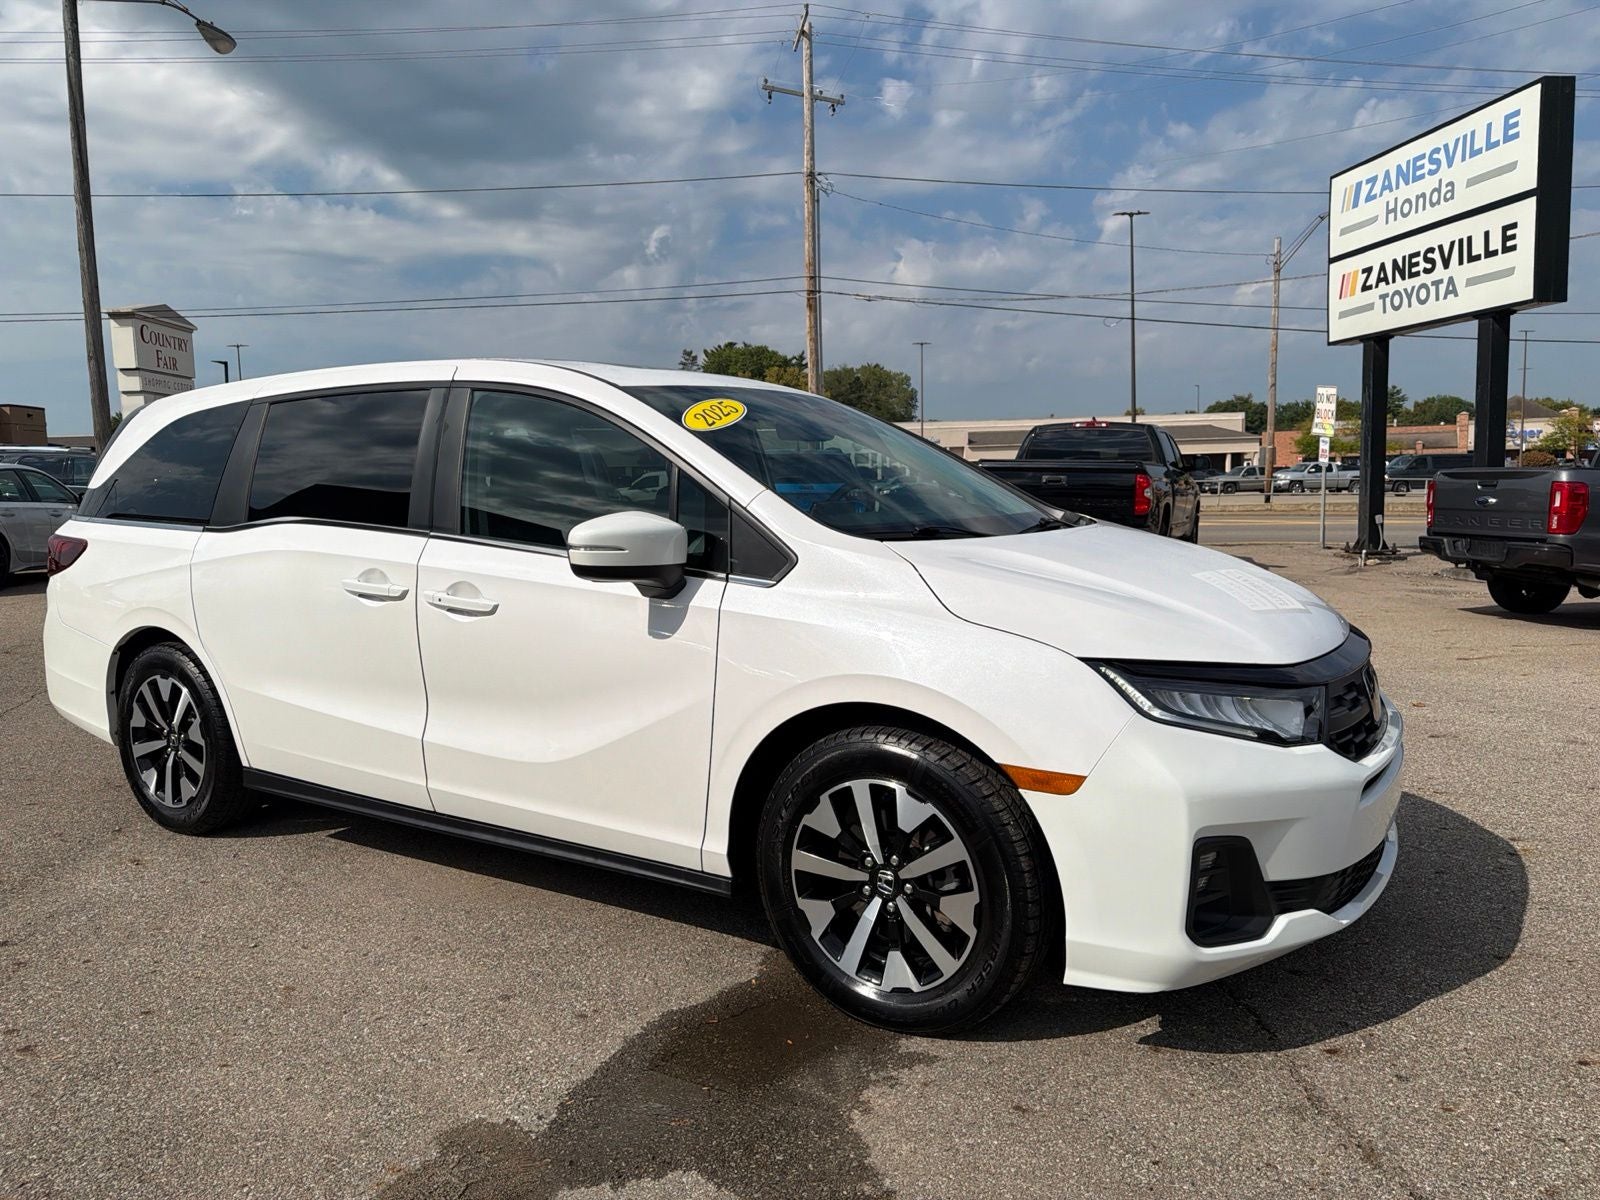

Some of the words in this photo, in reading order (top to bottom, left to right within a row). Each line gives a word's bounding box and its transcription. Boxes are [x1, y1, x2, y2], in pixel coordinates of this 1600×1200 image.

[1364, 108, 1521, 204] ZANESVILLE
[1385, 178, 1456, 225] Honda
[1360, 221, 1518, 293] ZANESVILLE
[1379, 276, 1459, 314] TOYOTA
[140, 324, 189, 353] COUNTRY
[155, 349, 179, 371] FAIR
[693, 401, 739, 427] 2025
[1316, 408, 1335, 420] BLOCK
